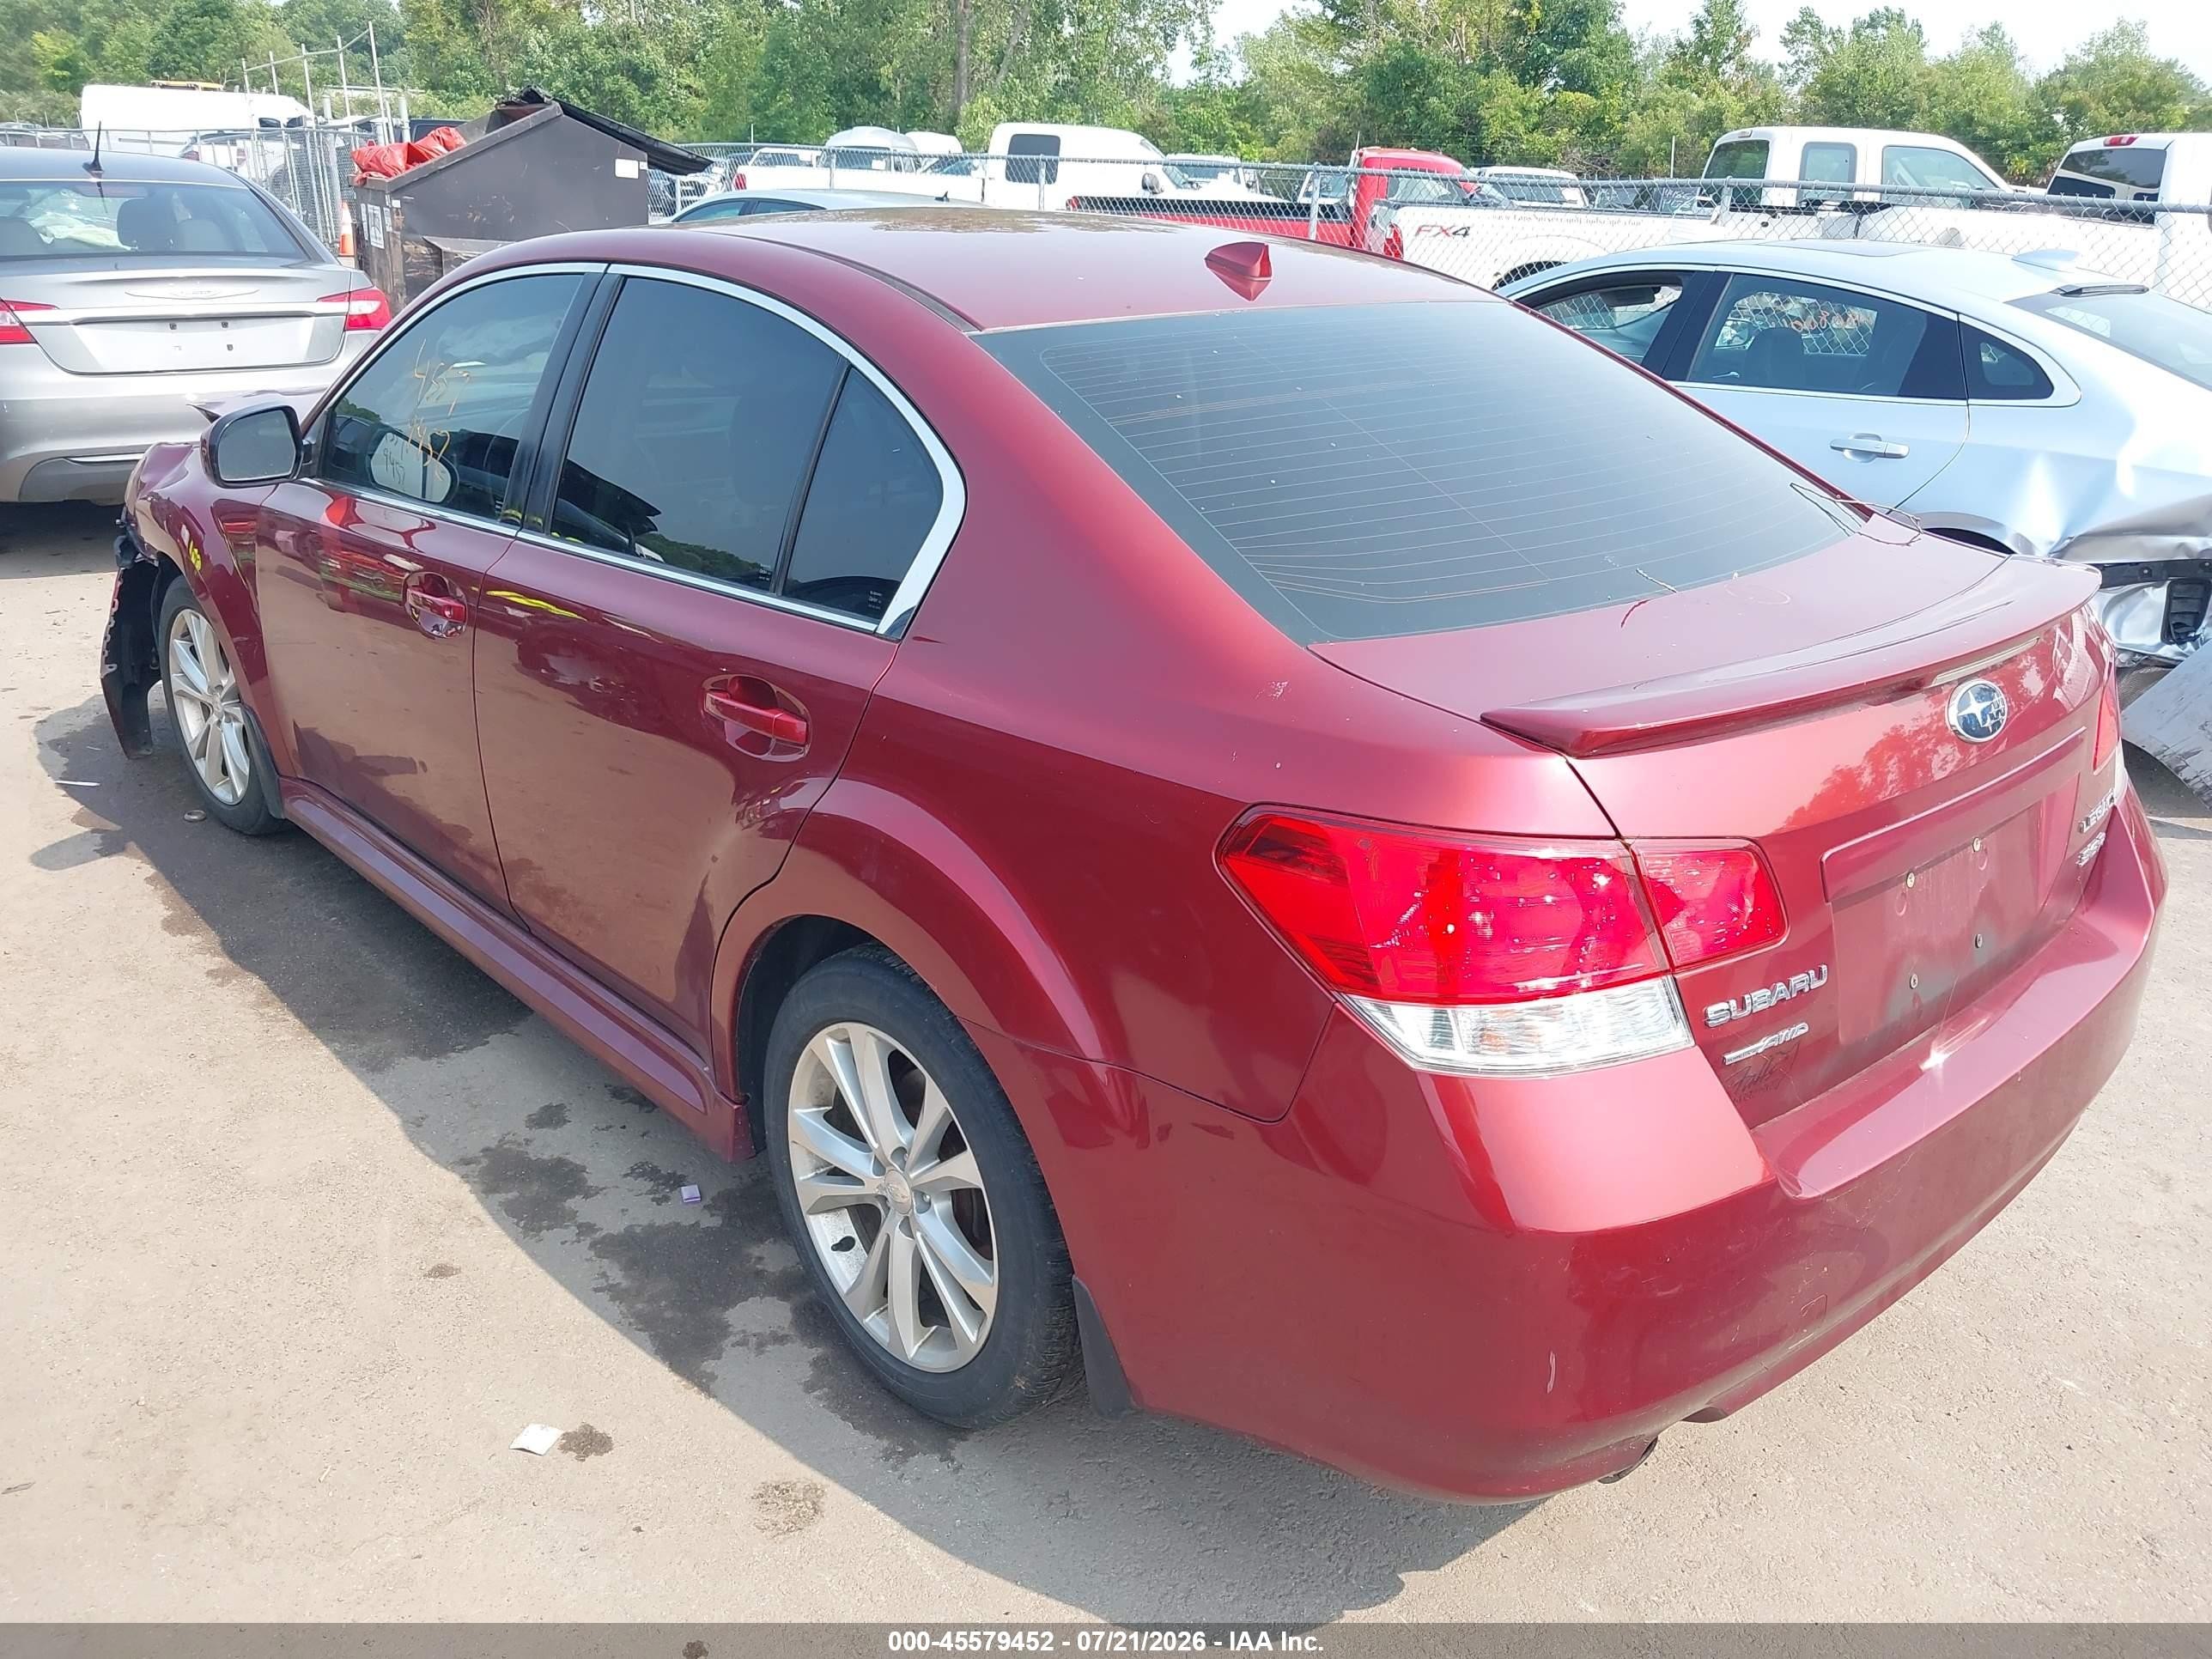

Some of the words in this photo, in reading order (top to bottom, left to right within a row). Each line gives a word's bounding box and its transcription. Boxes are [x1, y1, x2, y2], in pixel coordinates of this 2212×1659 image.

[1414, 224, 1470, 238] FX4
[1705, 963, 1828, 1028] SUBARU
[1758, 1022, 1810, 1054] AWD
